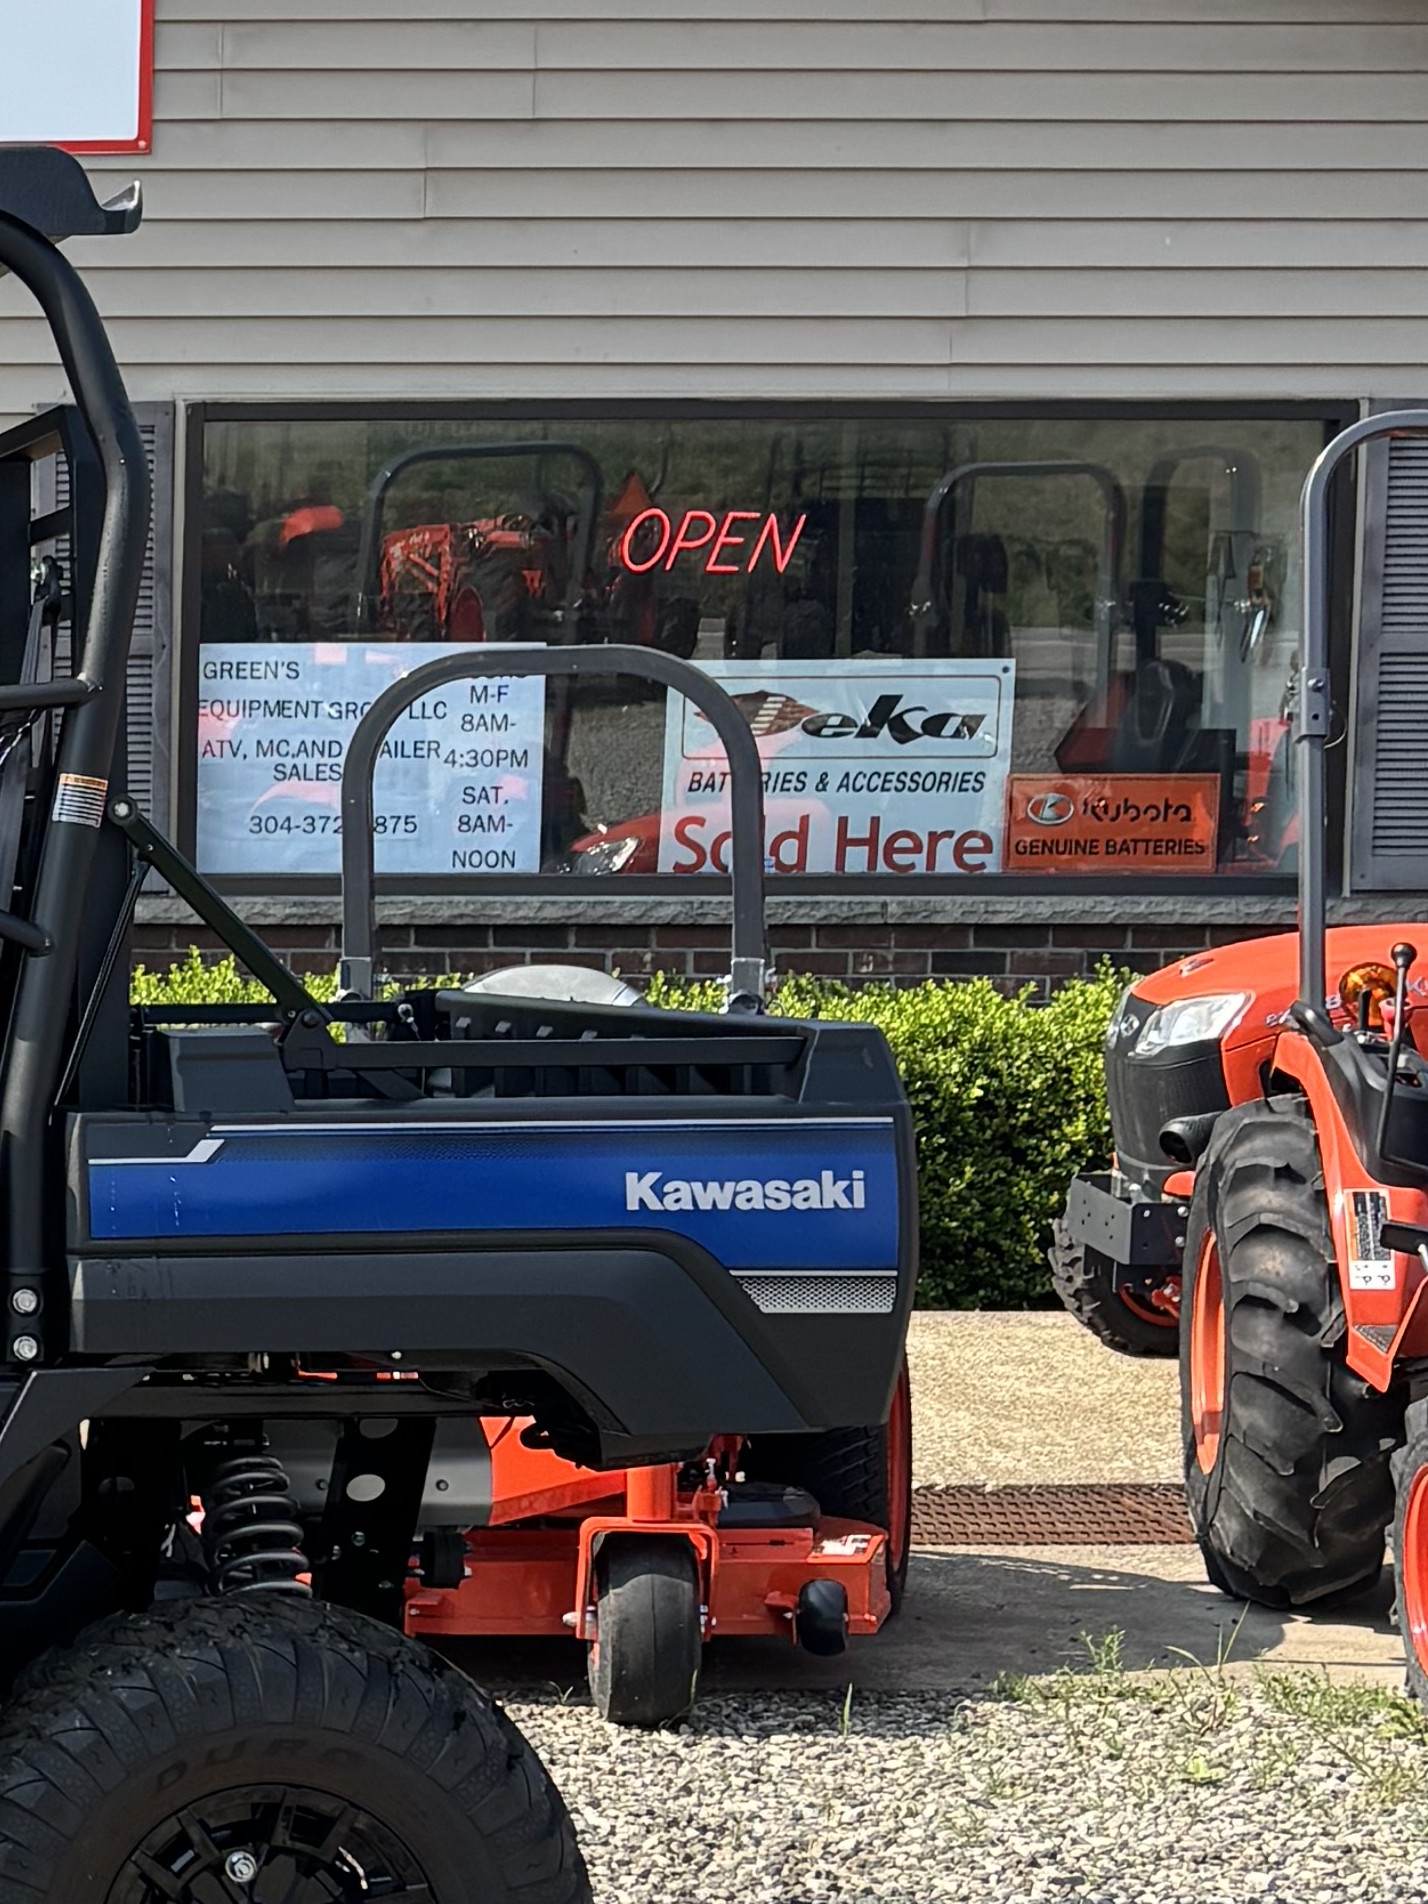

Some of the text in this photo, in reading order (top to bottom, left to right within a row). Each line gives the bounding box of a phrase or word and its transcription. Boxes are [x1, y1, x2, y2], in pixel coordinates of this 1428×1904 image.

[620, 506, 807, 575] OPEN
[202, 660, 300, 680] GREEN'S
[469, 684, 510, 704] M-F
[198, 699, 324, 720] EQUIPMENT
[408, 700, 448, 720] LLC
[460, 712, 517, 733] 8AM-
[379, 739, 441, 759] AILER
[443, 748, 529, 768] 4:30PM
[273, 763, 343, 782] SALES
[687, 771, 987, 793] BATRIES & ACCESSORIES
[248, 815, 418, 835] 304-372875
[457, 814, 514, 834] 8AM-
[672, 814, 994, 874] Sod Here
[1014, 838, 1206, 856] GENUINE BATTERIES
[452, 849, 516, 869] NOON
[625, 1169, 866, 1211] Kawasaki
